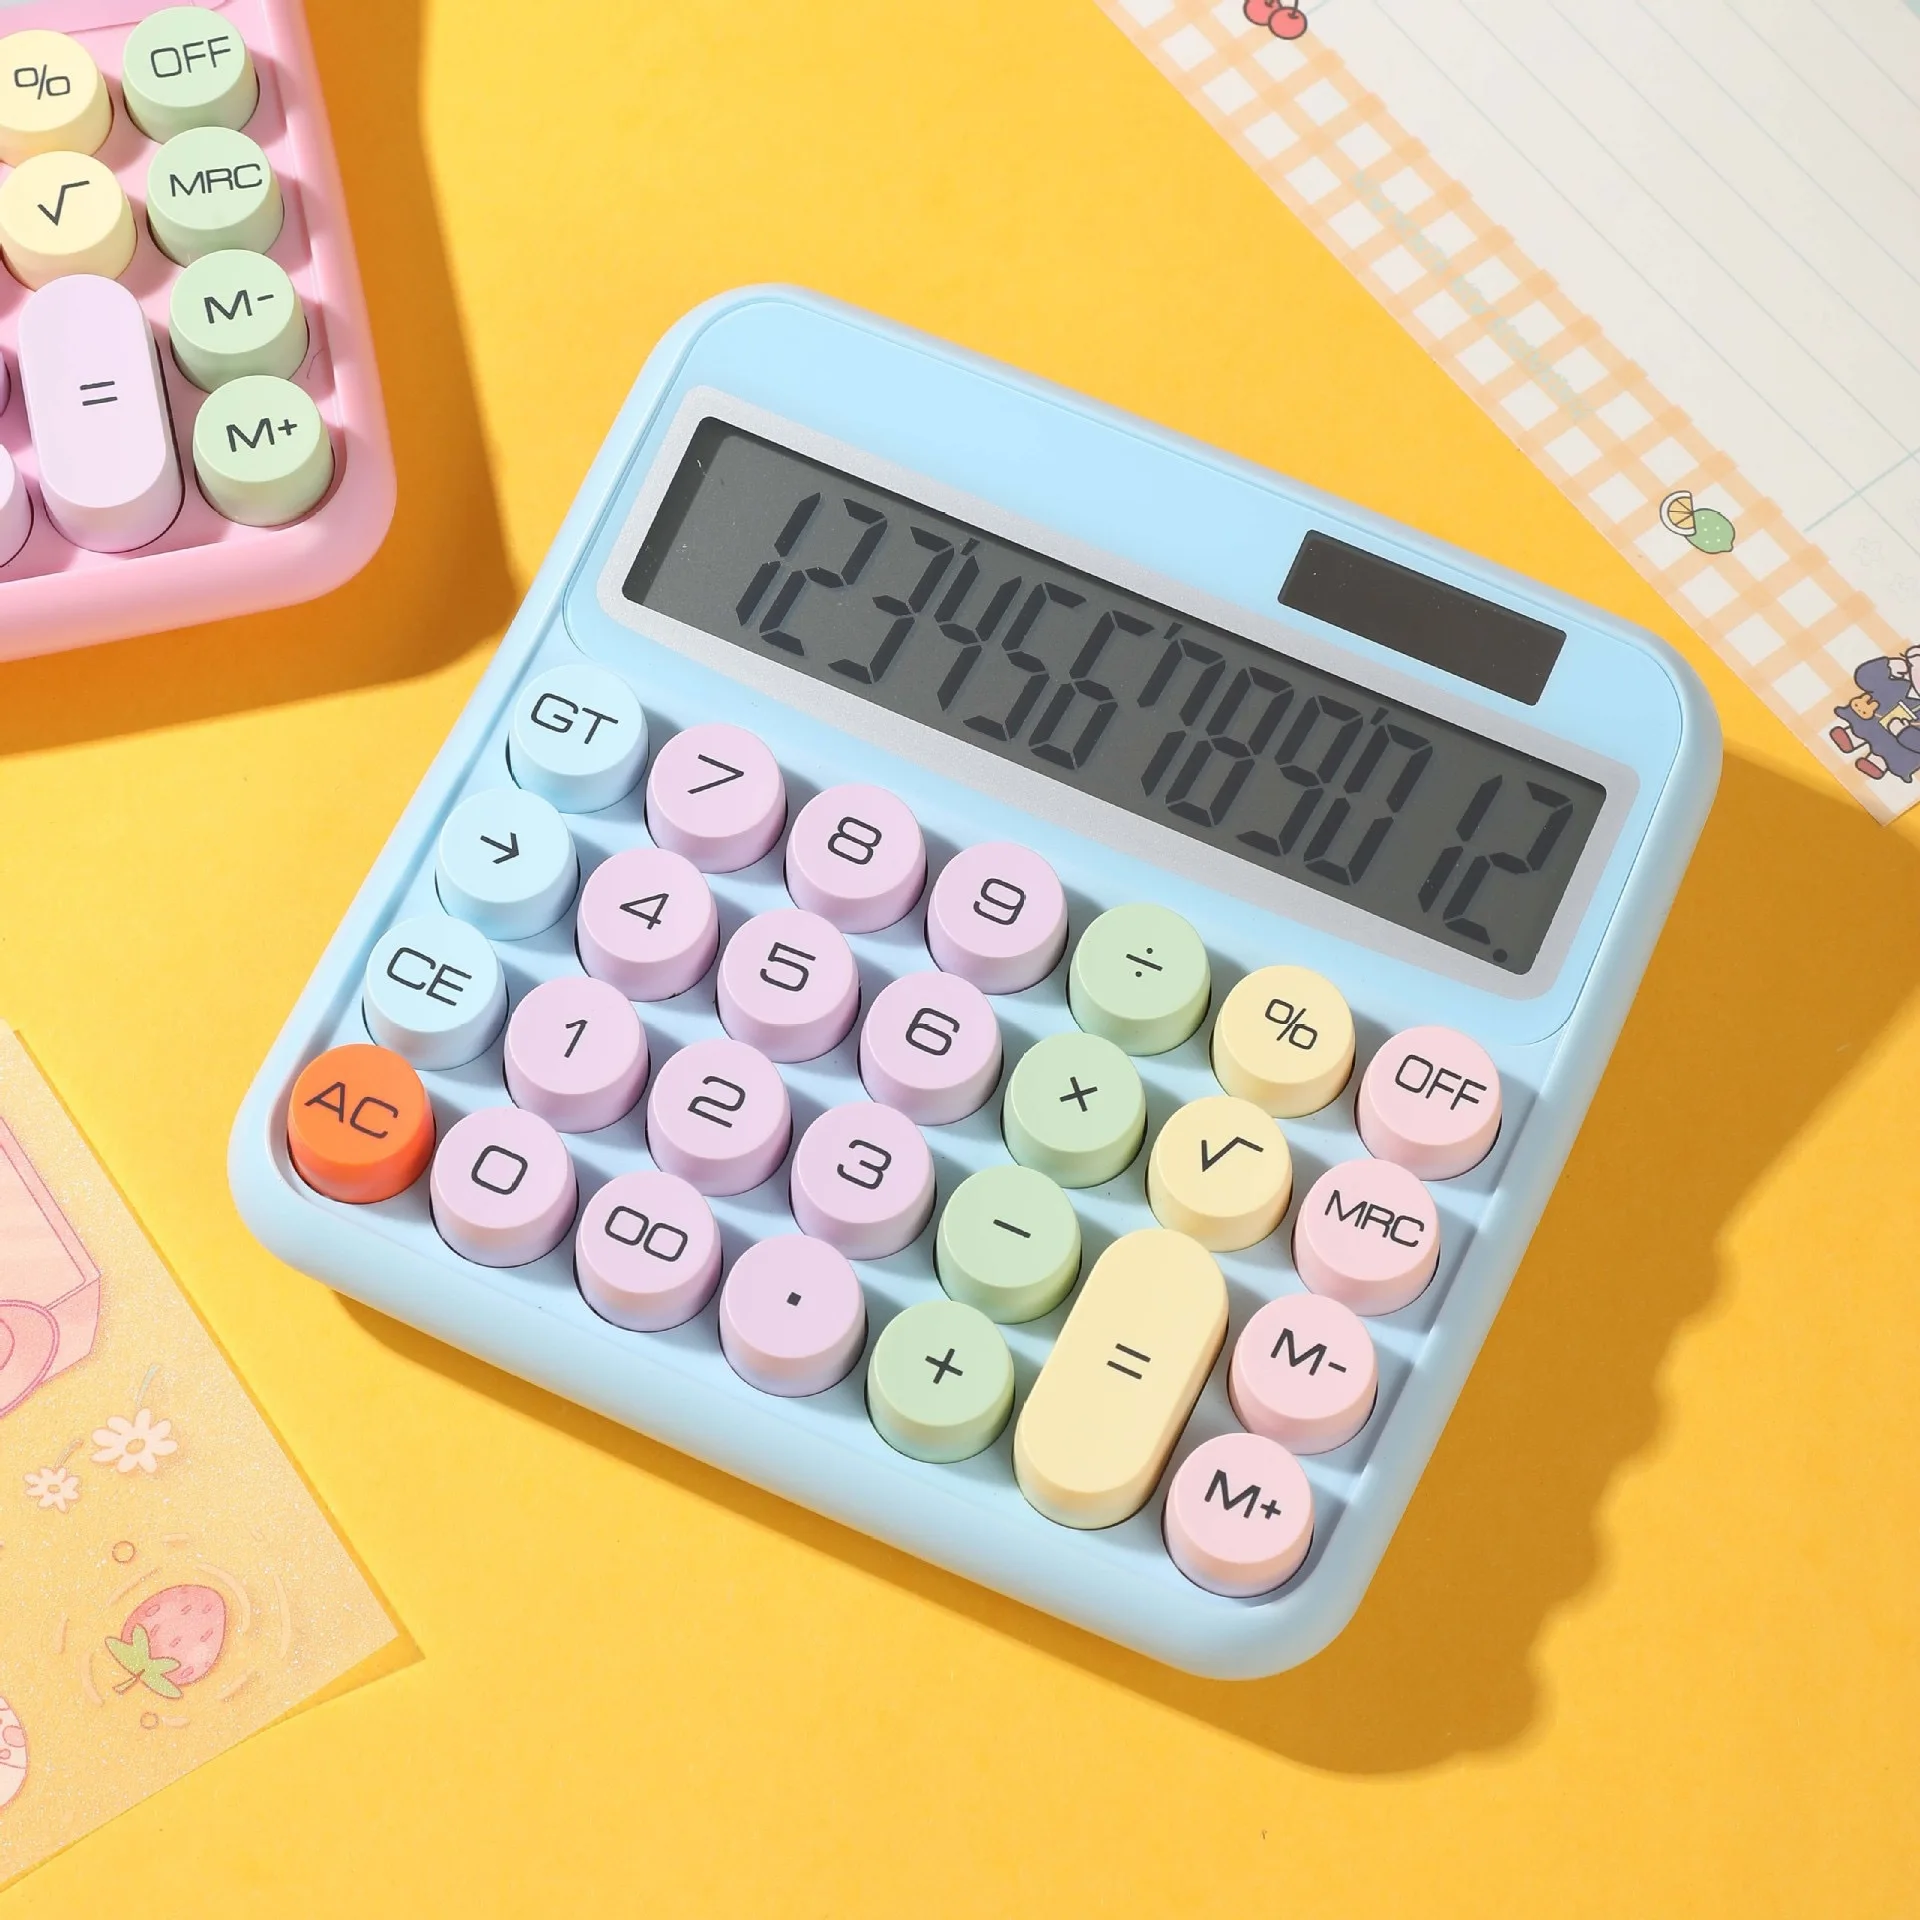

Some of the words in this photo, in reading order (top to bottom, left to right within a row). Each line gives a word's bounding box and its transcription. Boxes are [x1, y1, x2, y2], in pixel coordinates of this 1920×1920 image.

[150, 35, 231, 78] OFF
[14, 64, 71, 100] %
[169, 163, 263, 197] MRC
[203, 289, 274, 324] M-
[226, 417, 298, 453] M+
[530, 692, 619, 745] GT
[687, 754, 745, 795] 7
[827, 816, 882, 865] 8
[619, 892, 670, 930] 4
[973, 878, 1027, 926] 9
[386, 947, 472, 1007] CE
[759, 941, 817, 992] 5
[564, 1019, 588, 1059] 1
[905, 1007, 960, 1056] 6
[1264, 998, 1318, 1050] %
[687, 1075, 746, 1129] 2
[1394, 1054, 1488, 1111] OFF
[304, 1081, 399, 1139] AC
[471, 1144, 528, 1196] 0
[836, 1139, 892, 1190] 3
[604, 1205, 689, 1263] 00
[1324, 1189, 1425, 1248] MRC
[1270, 1327, 1347, 1376] M-
[1204, 1469, 1282, 1520] M+
